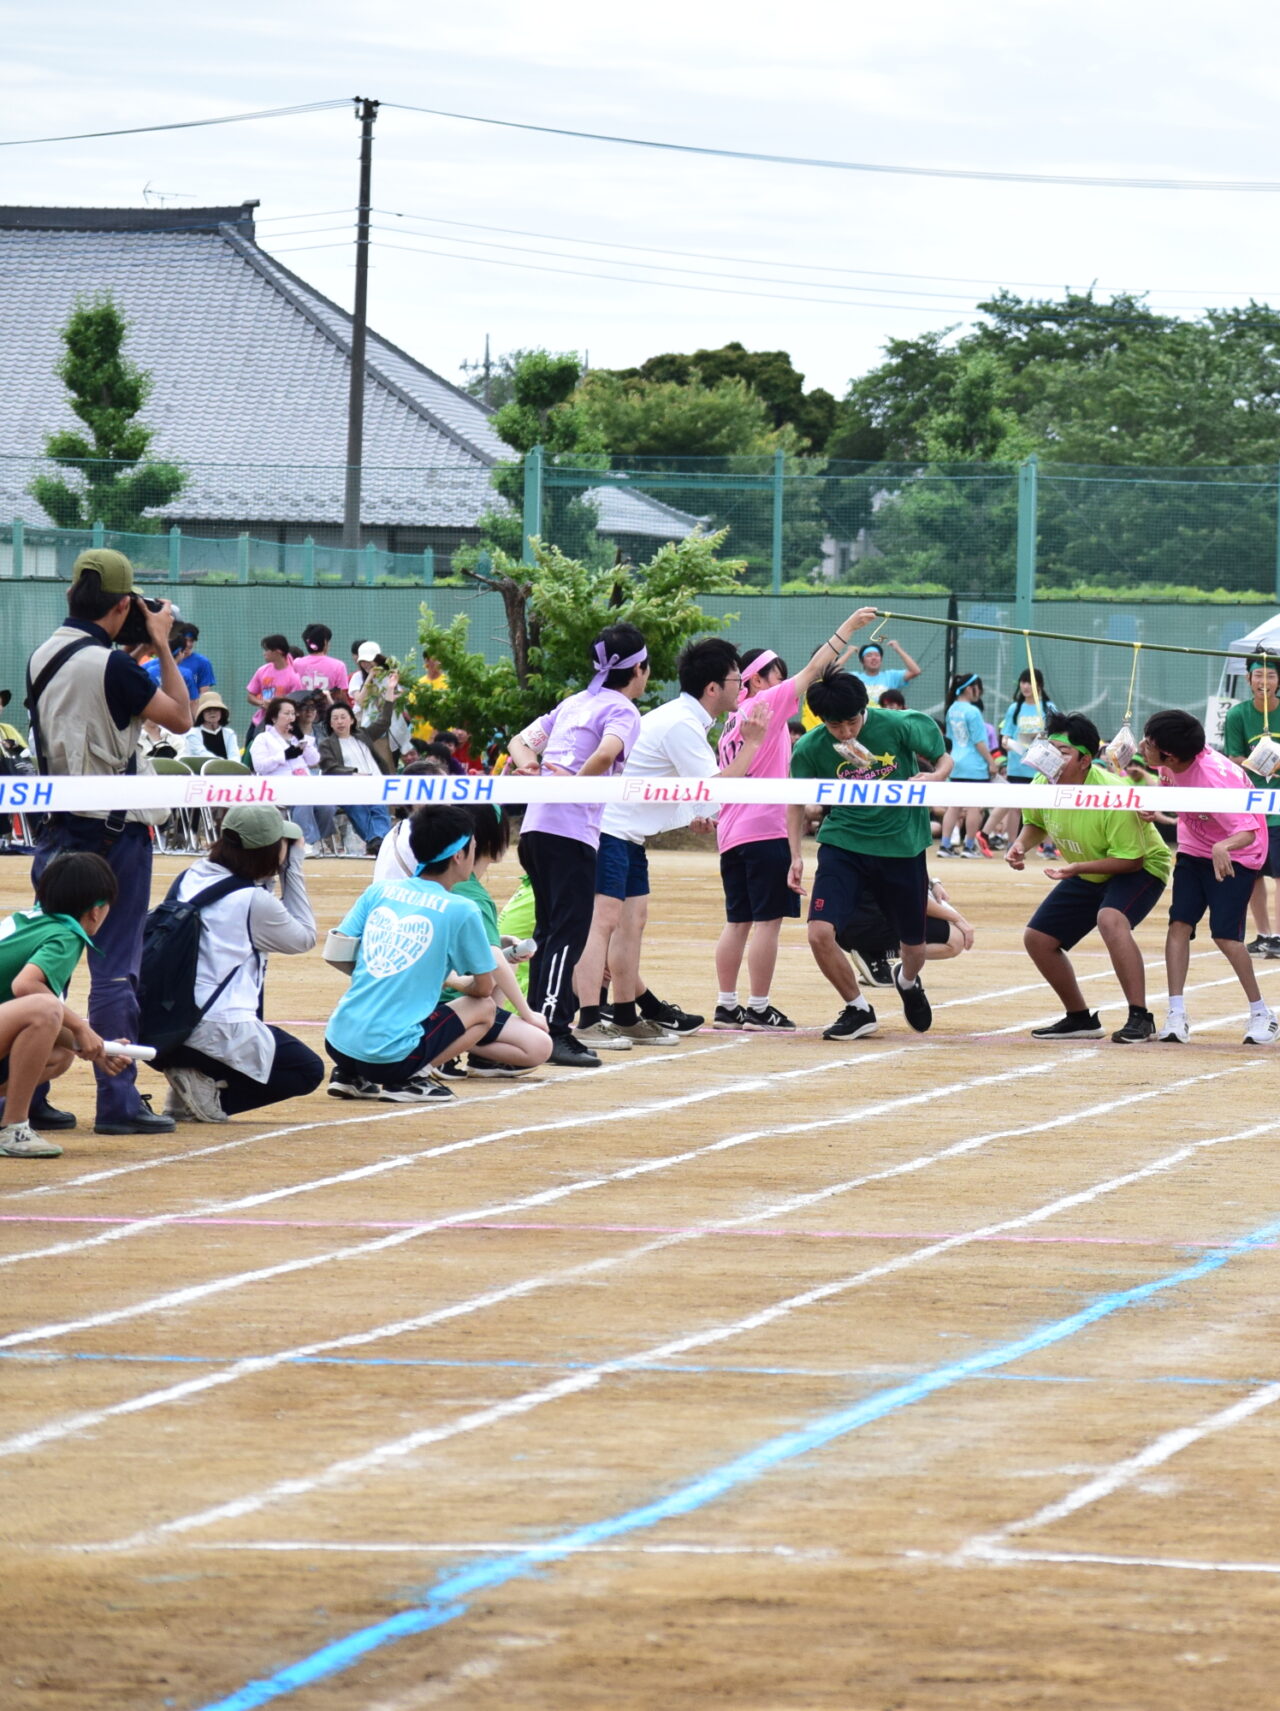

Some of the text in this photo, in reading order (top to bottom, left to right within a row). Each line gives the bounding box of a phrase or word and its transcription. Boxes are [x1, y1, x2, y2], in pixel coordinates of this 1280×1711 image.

[184, 780, 276, 802] Finish
[382, 778, 494, 801] FINISH
[623, 779, 714, 801] Finish
[816, 783, 926, 804] FINISH
[1053, 787, 1144, 809] Finish
